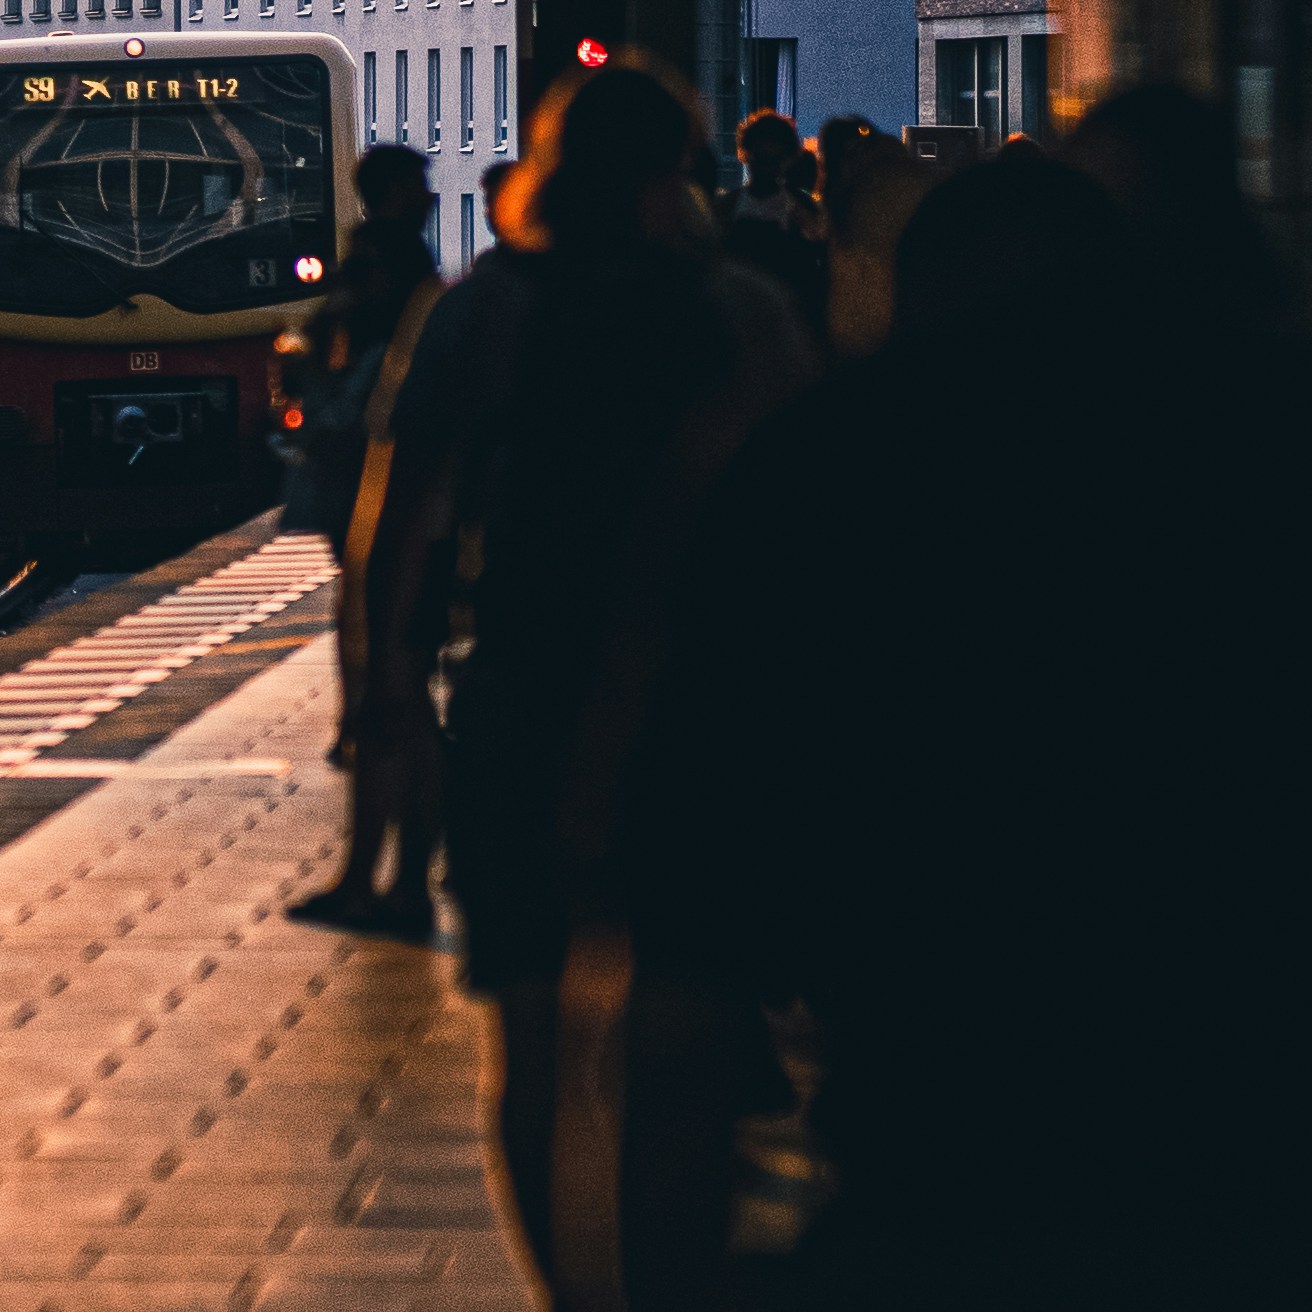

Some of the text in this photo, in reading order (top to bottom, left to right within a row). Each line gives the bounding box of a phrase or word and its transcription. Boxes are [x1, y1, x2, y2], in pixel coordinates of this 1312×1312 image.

[24, 77, 55, 102] S9
[197, 78, 239, 99] T1-2
[254, 259, 270, 285] 3
[132, 353, 158, 370] DB
